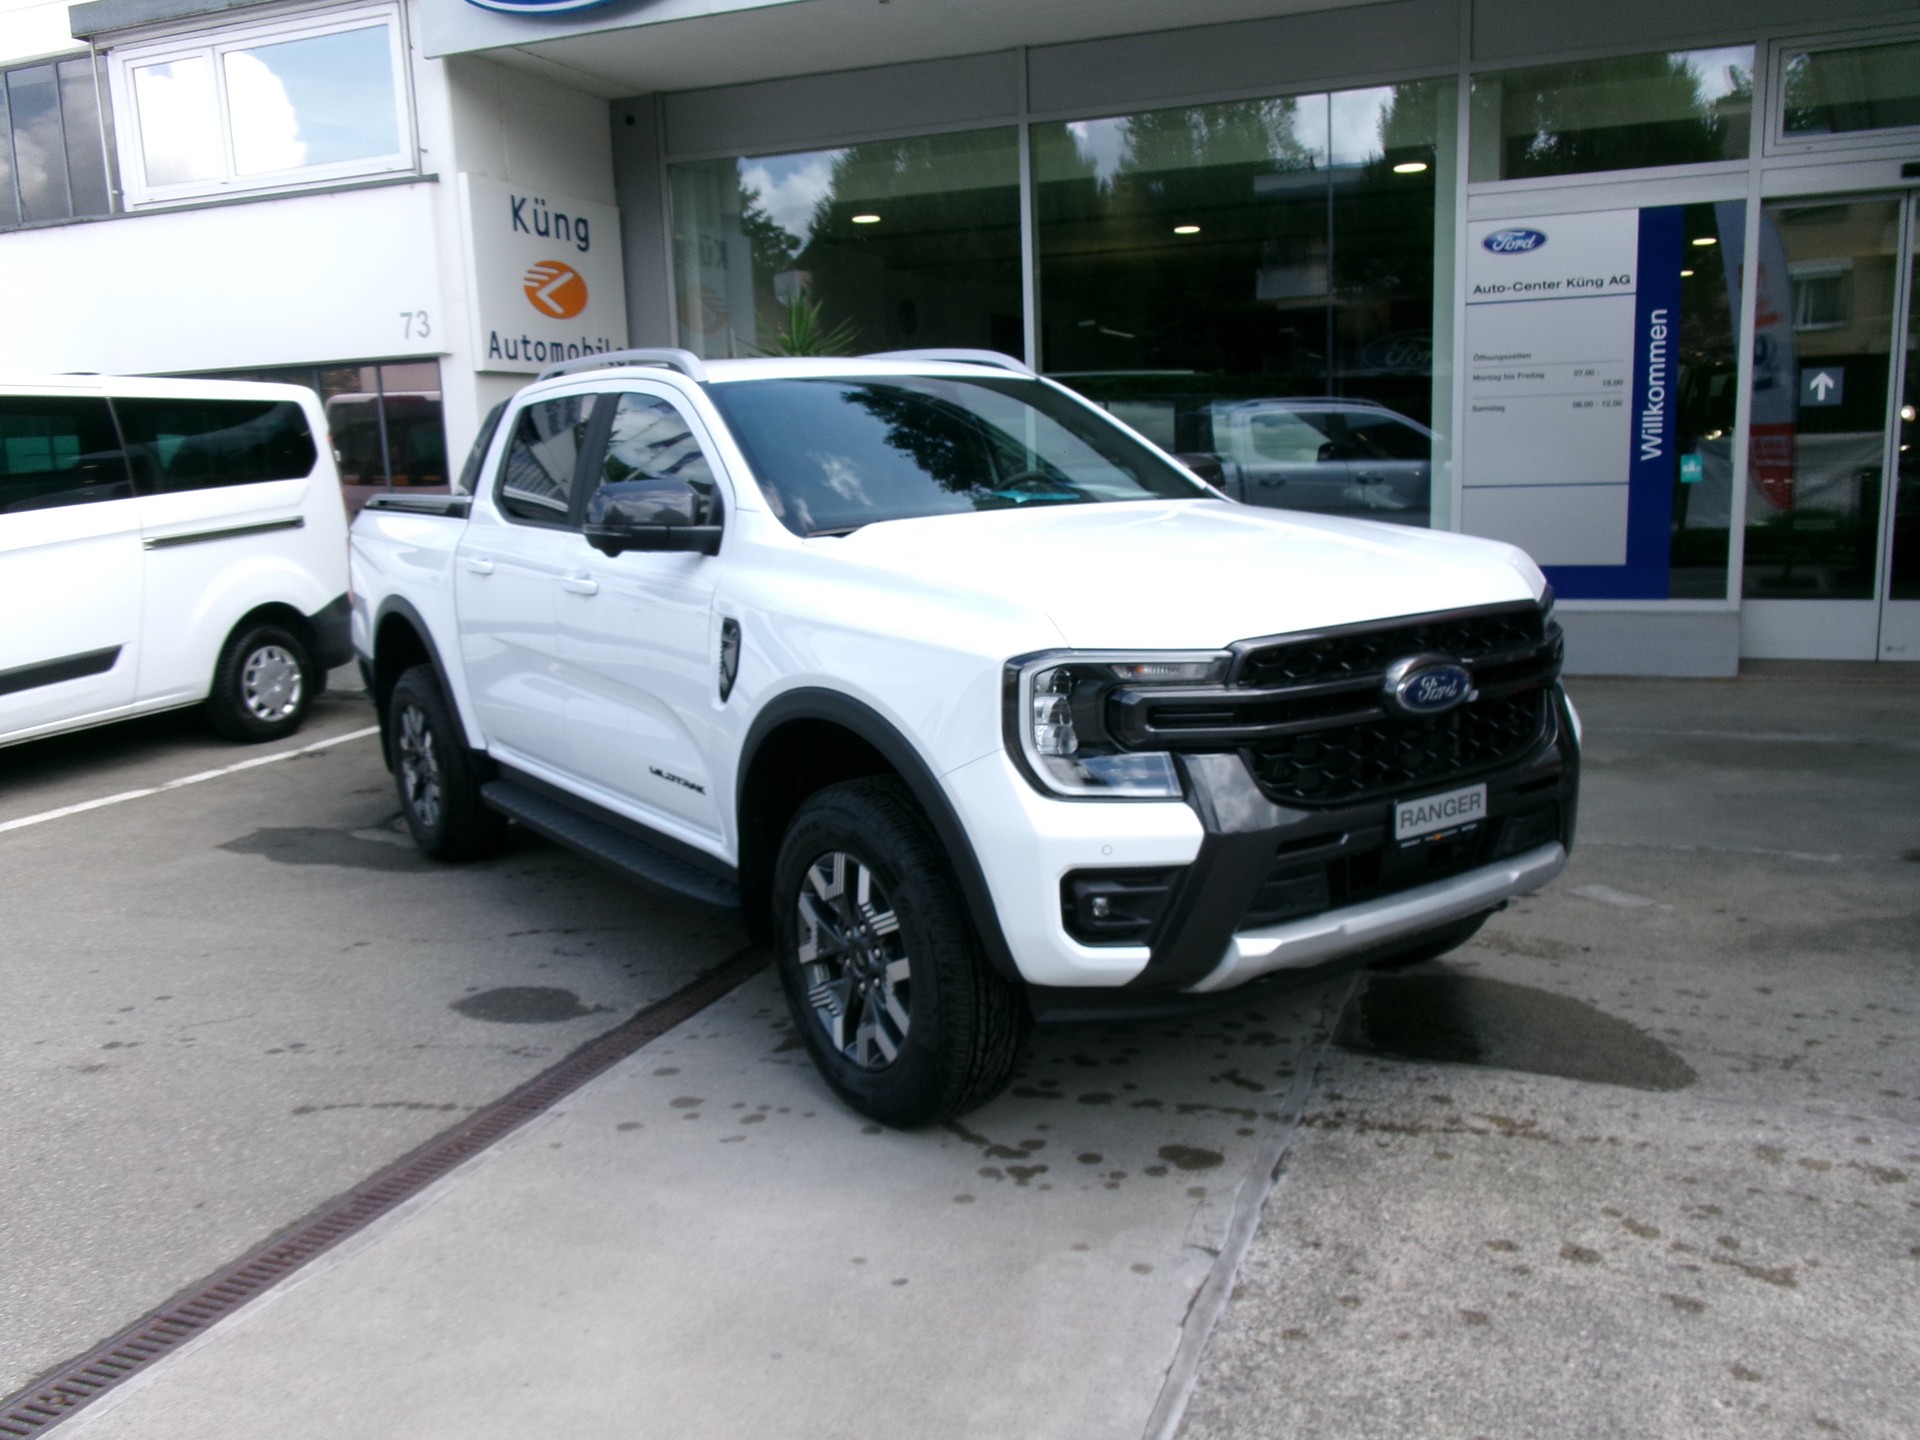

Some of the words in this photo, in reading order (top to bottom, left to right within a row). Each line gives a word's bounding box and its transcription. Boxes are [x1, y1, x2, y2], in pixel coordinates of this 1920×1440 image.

[510, 194, 591, 252] Küng
[1492, 231, 1536, 251] Ford
[1473, 280, 1562, 295] Auto-Center
[1566, 276, 1604, 289] Küng
[1609, 274, 1631, 286] AG
[399, 310, 431, 340] 73
[1472, 373, 1502, 382] Montag
[1517, 371, 1545, 380] Freitag
[1640, 308, 1668, 462] Willkommen
[1400, 791, 1482, 829] RANGER
